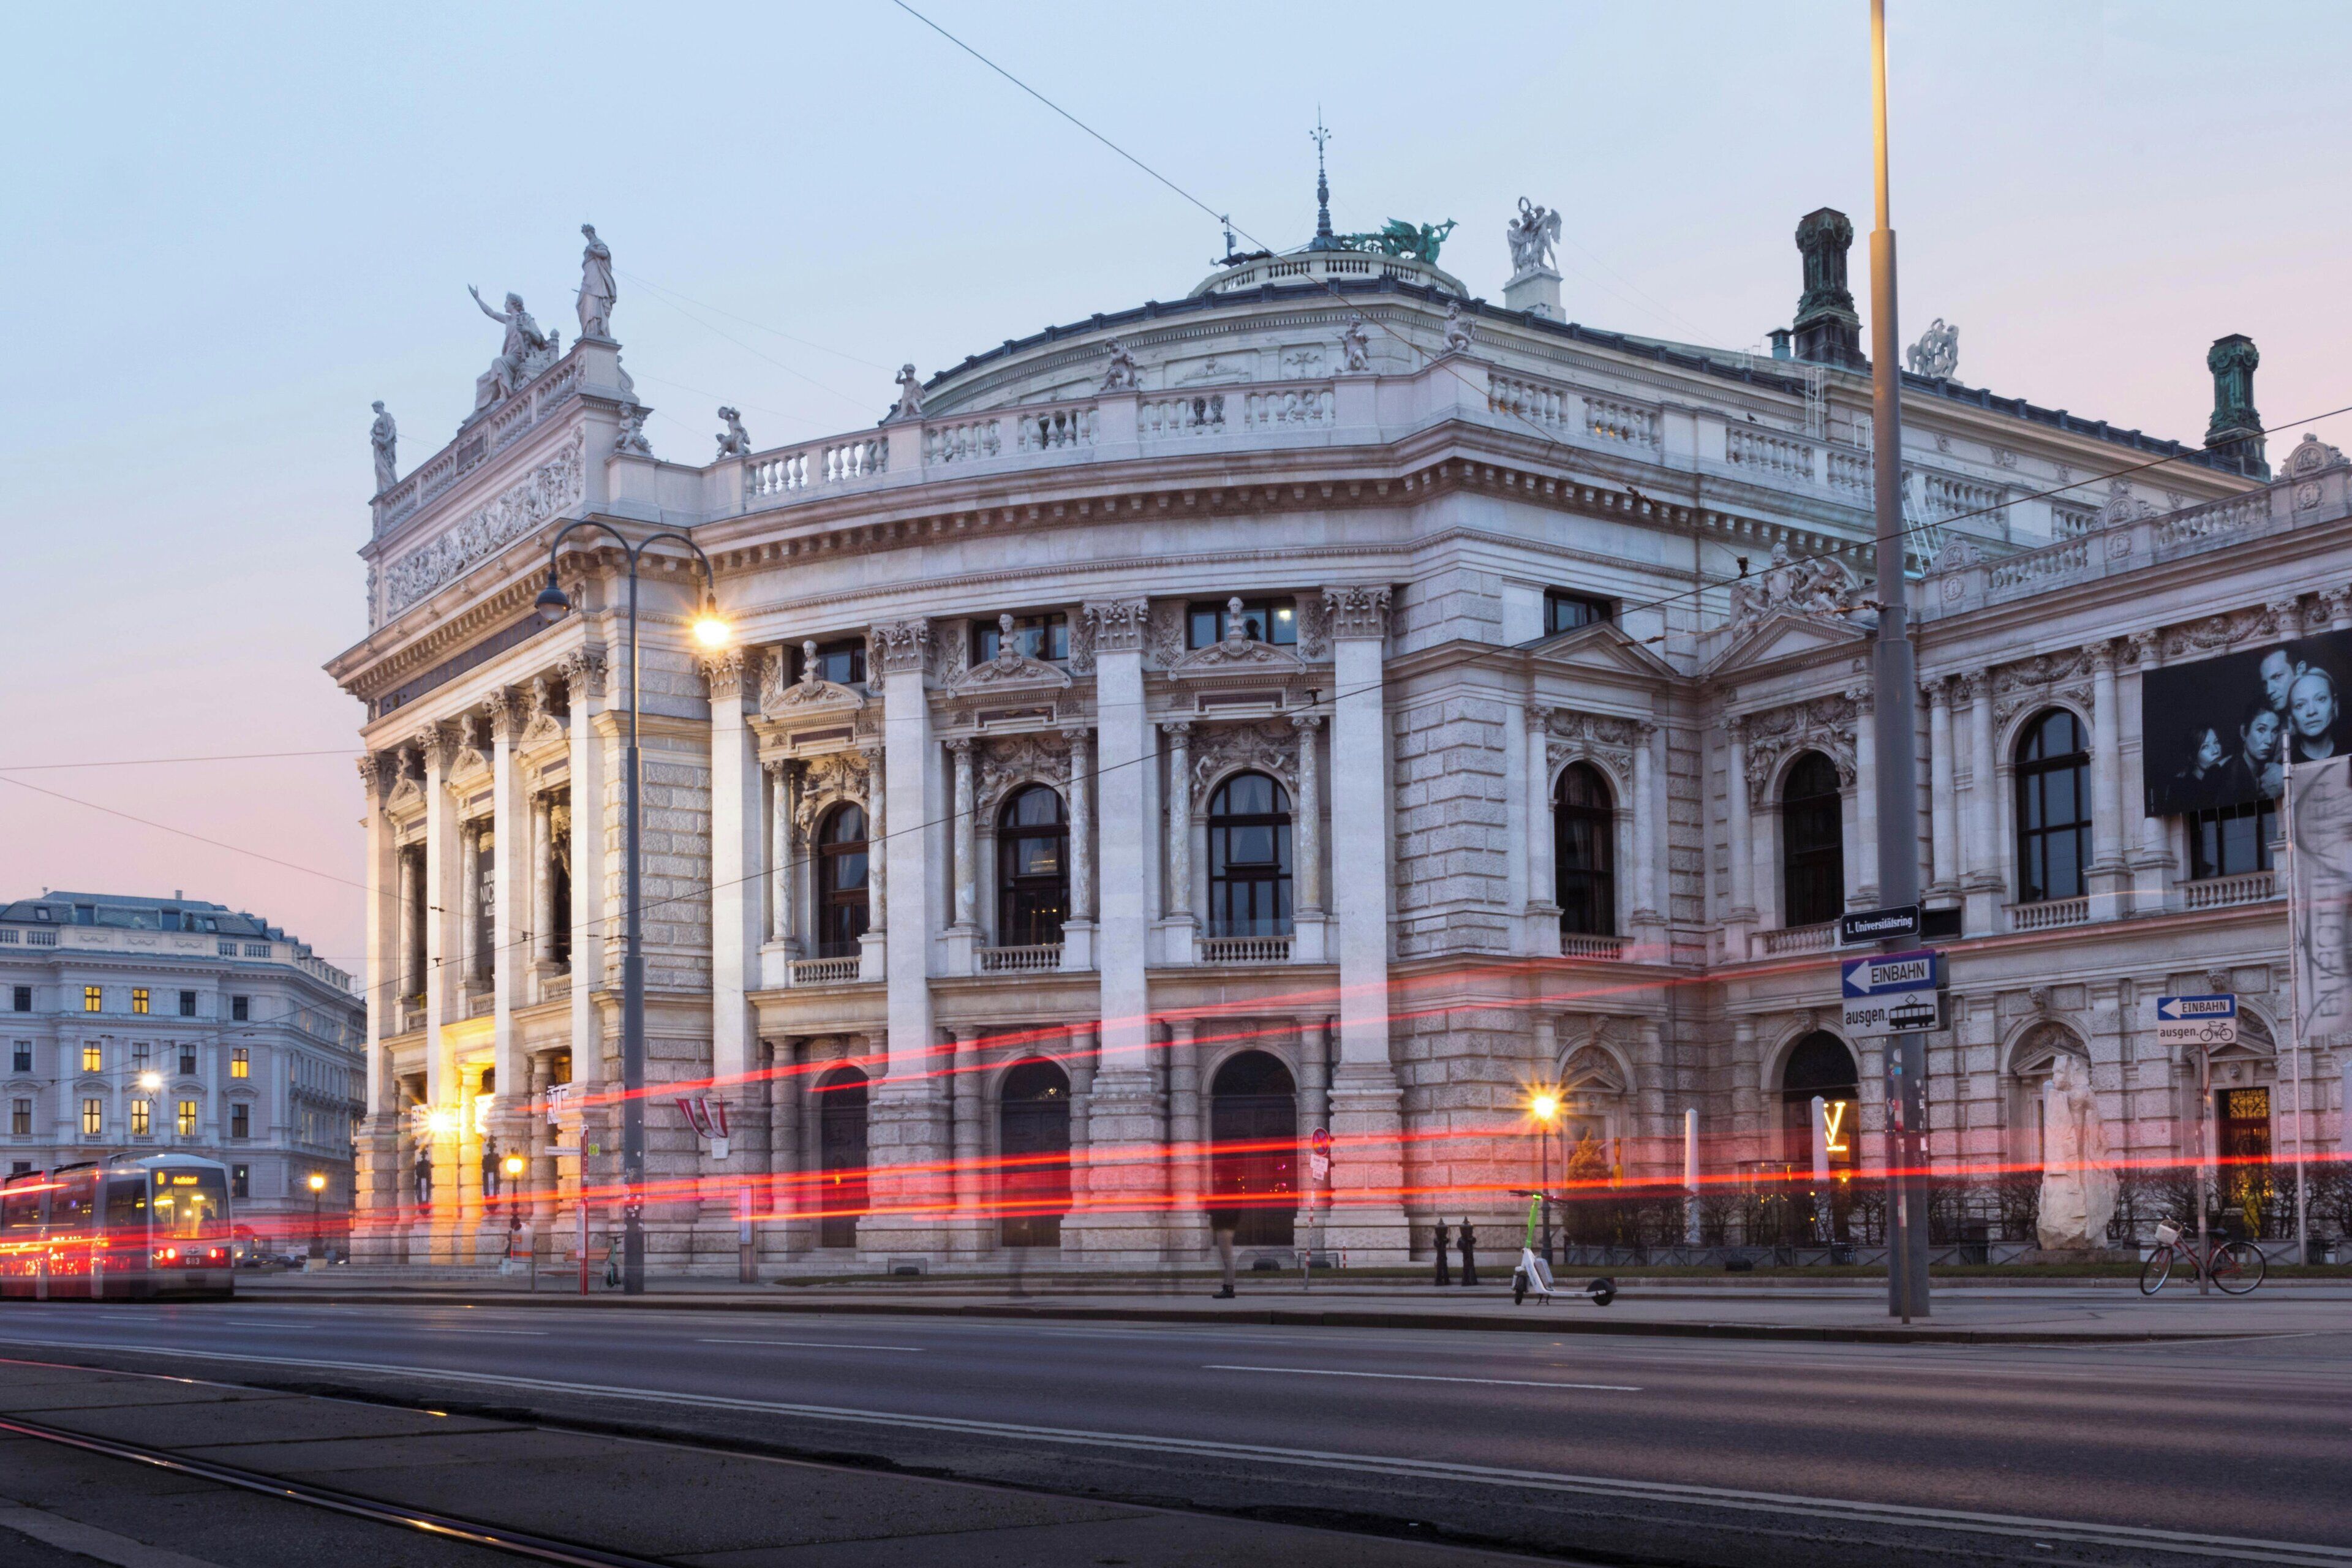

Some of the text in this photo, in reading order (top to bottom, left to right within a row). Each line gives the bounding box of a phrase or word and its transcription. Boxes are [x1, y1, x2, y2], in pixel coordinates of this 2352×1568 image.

[480, 883, 495, 903] NIC
[1847, 915, 1913, 933] 1. Universitätsring
[1872, 962, 1924, 984] EINBAHN
[2182, 1001, 2226, 1012] EINBAHN
[1846, 1008, 1888, 1027] ausgen.
[2160, 1028, 2199, 1039] ausgen.
[157, 1172, 165, 1185] D
